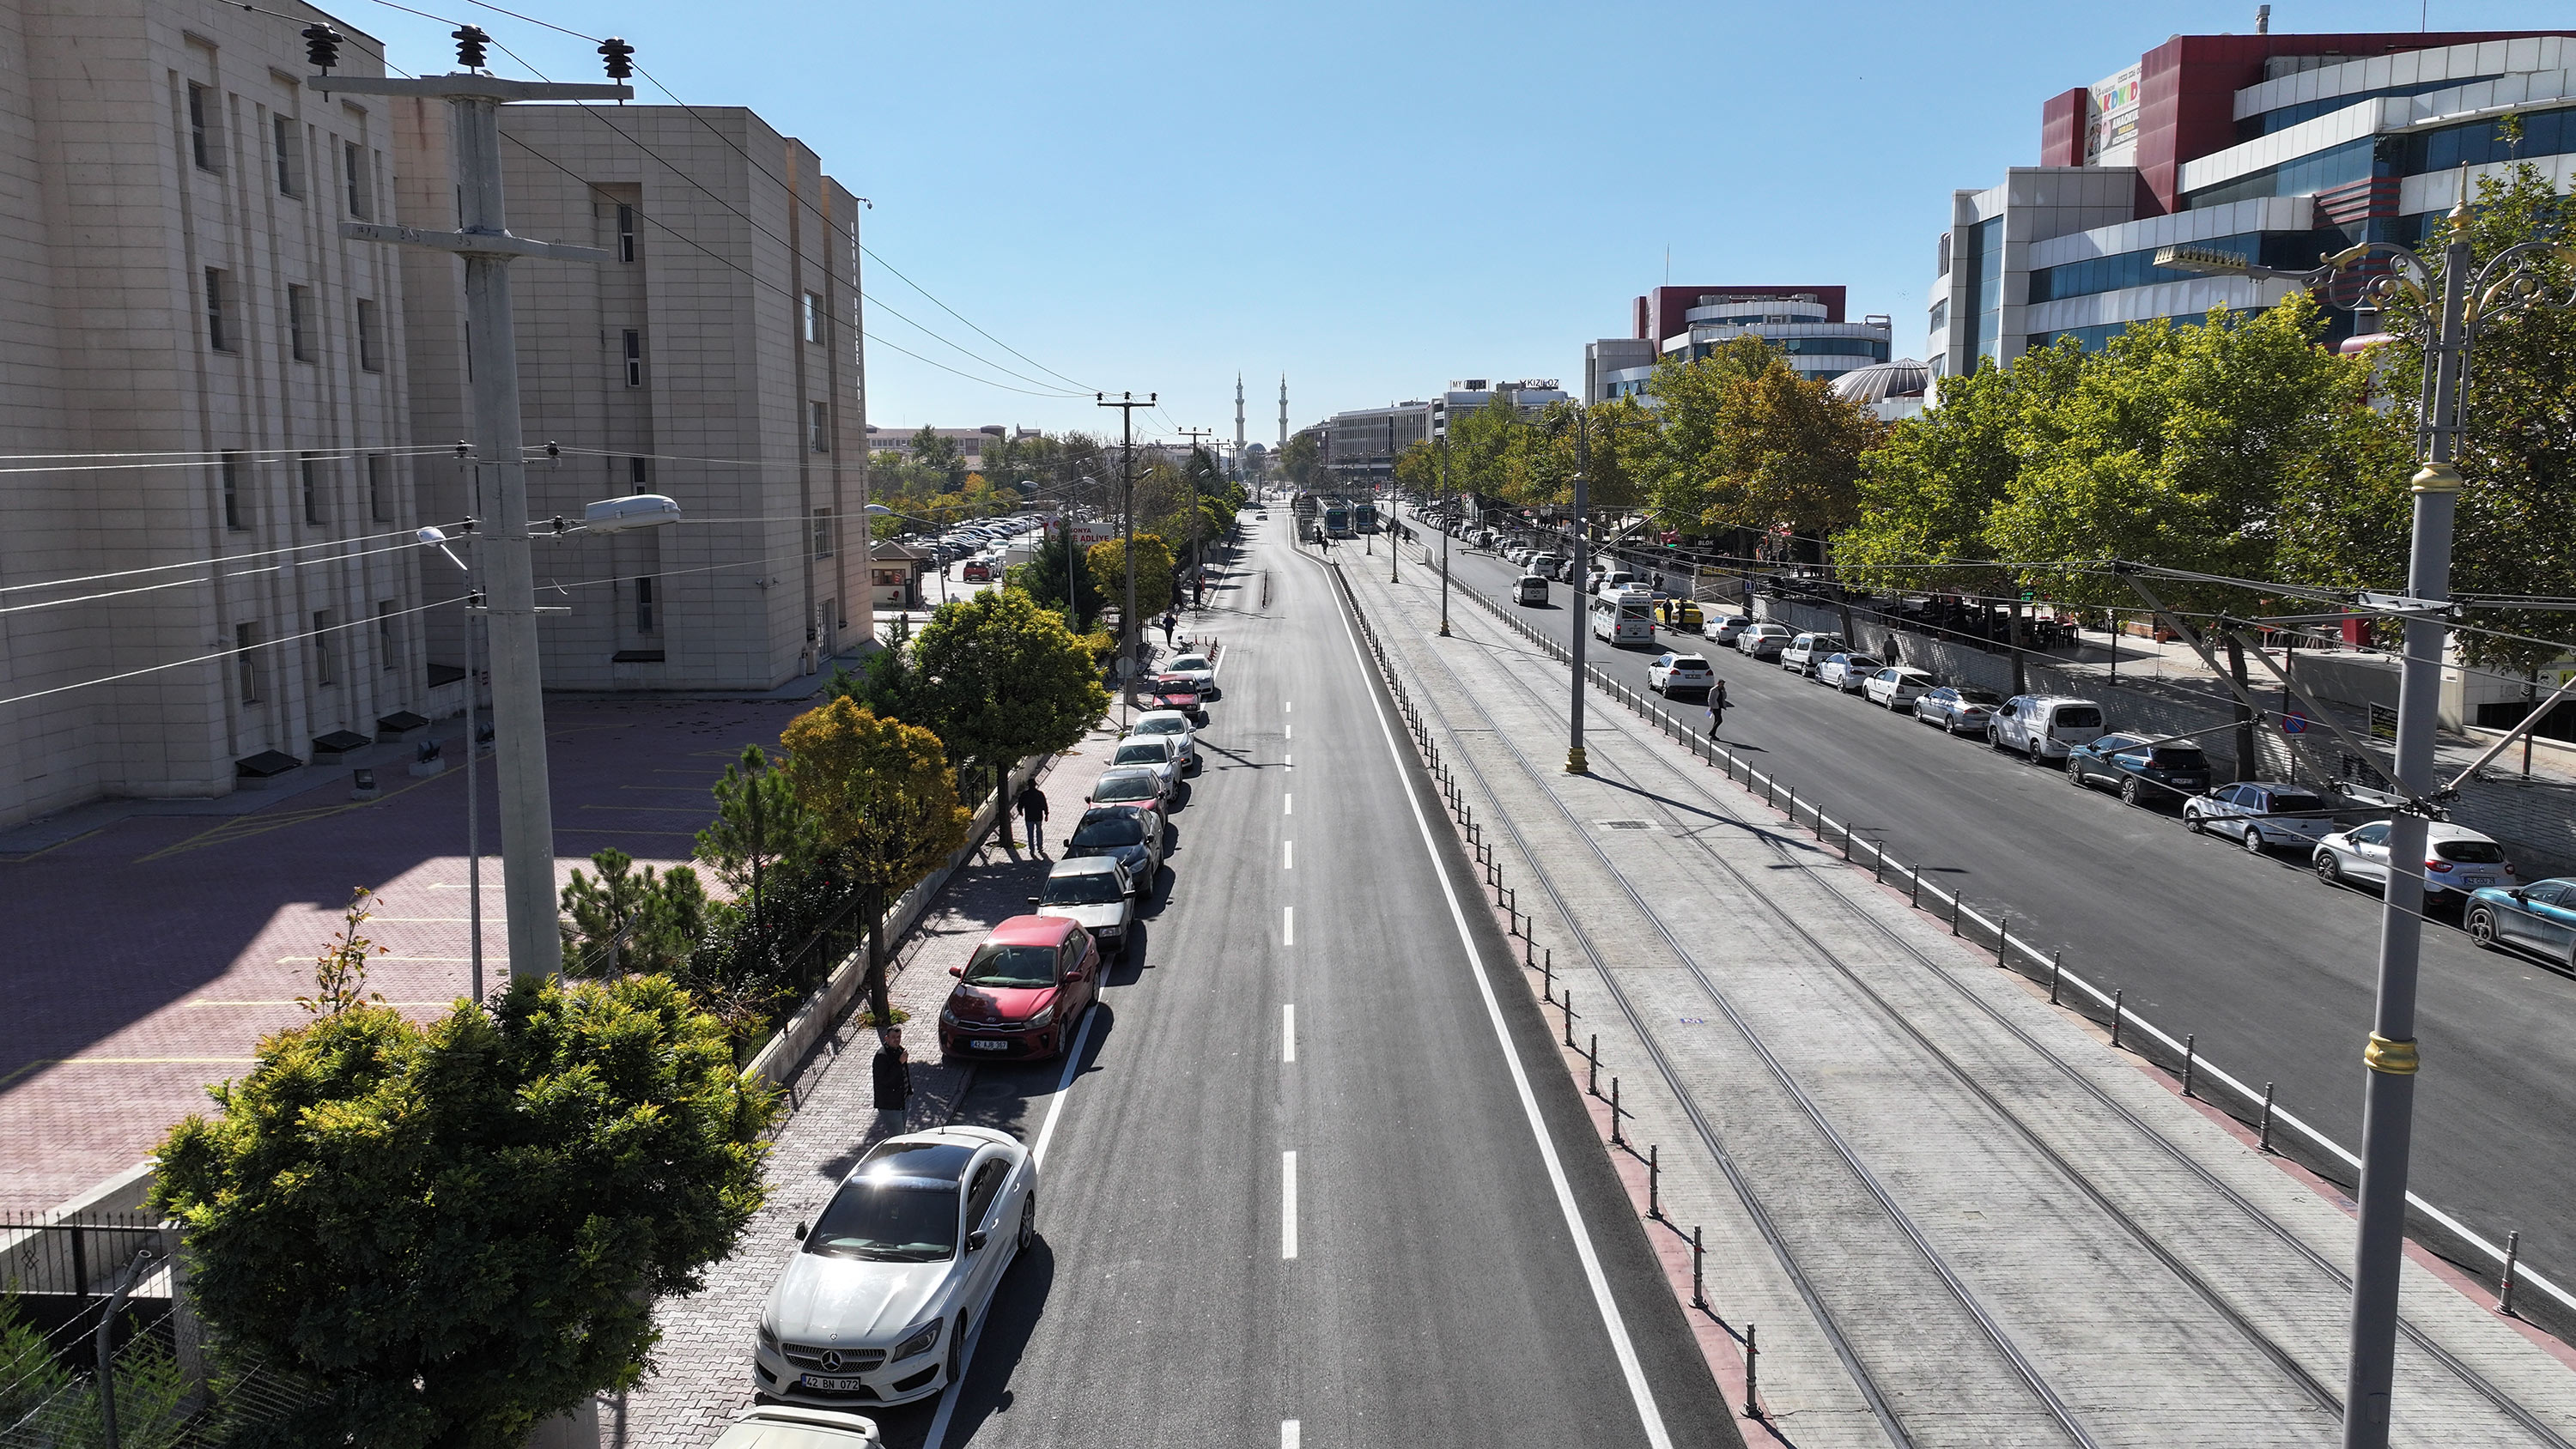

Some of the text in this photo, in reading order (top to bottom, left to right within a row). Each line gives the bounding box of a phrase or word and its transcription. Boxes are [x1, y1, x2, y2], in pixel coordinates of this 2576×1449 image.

[807, 1377, 859, 1390] 42 BN 072
